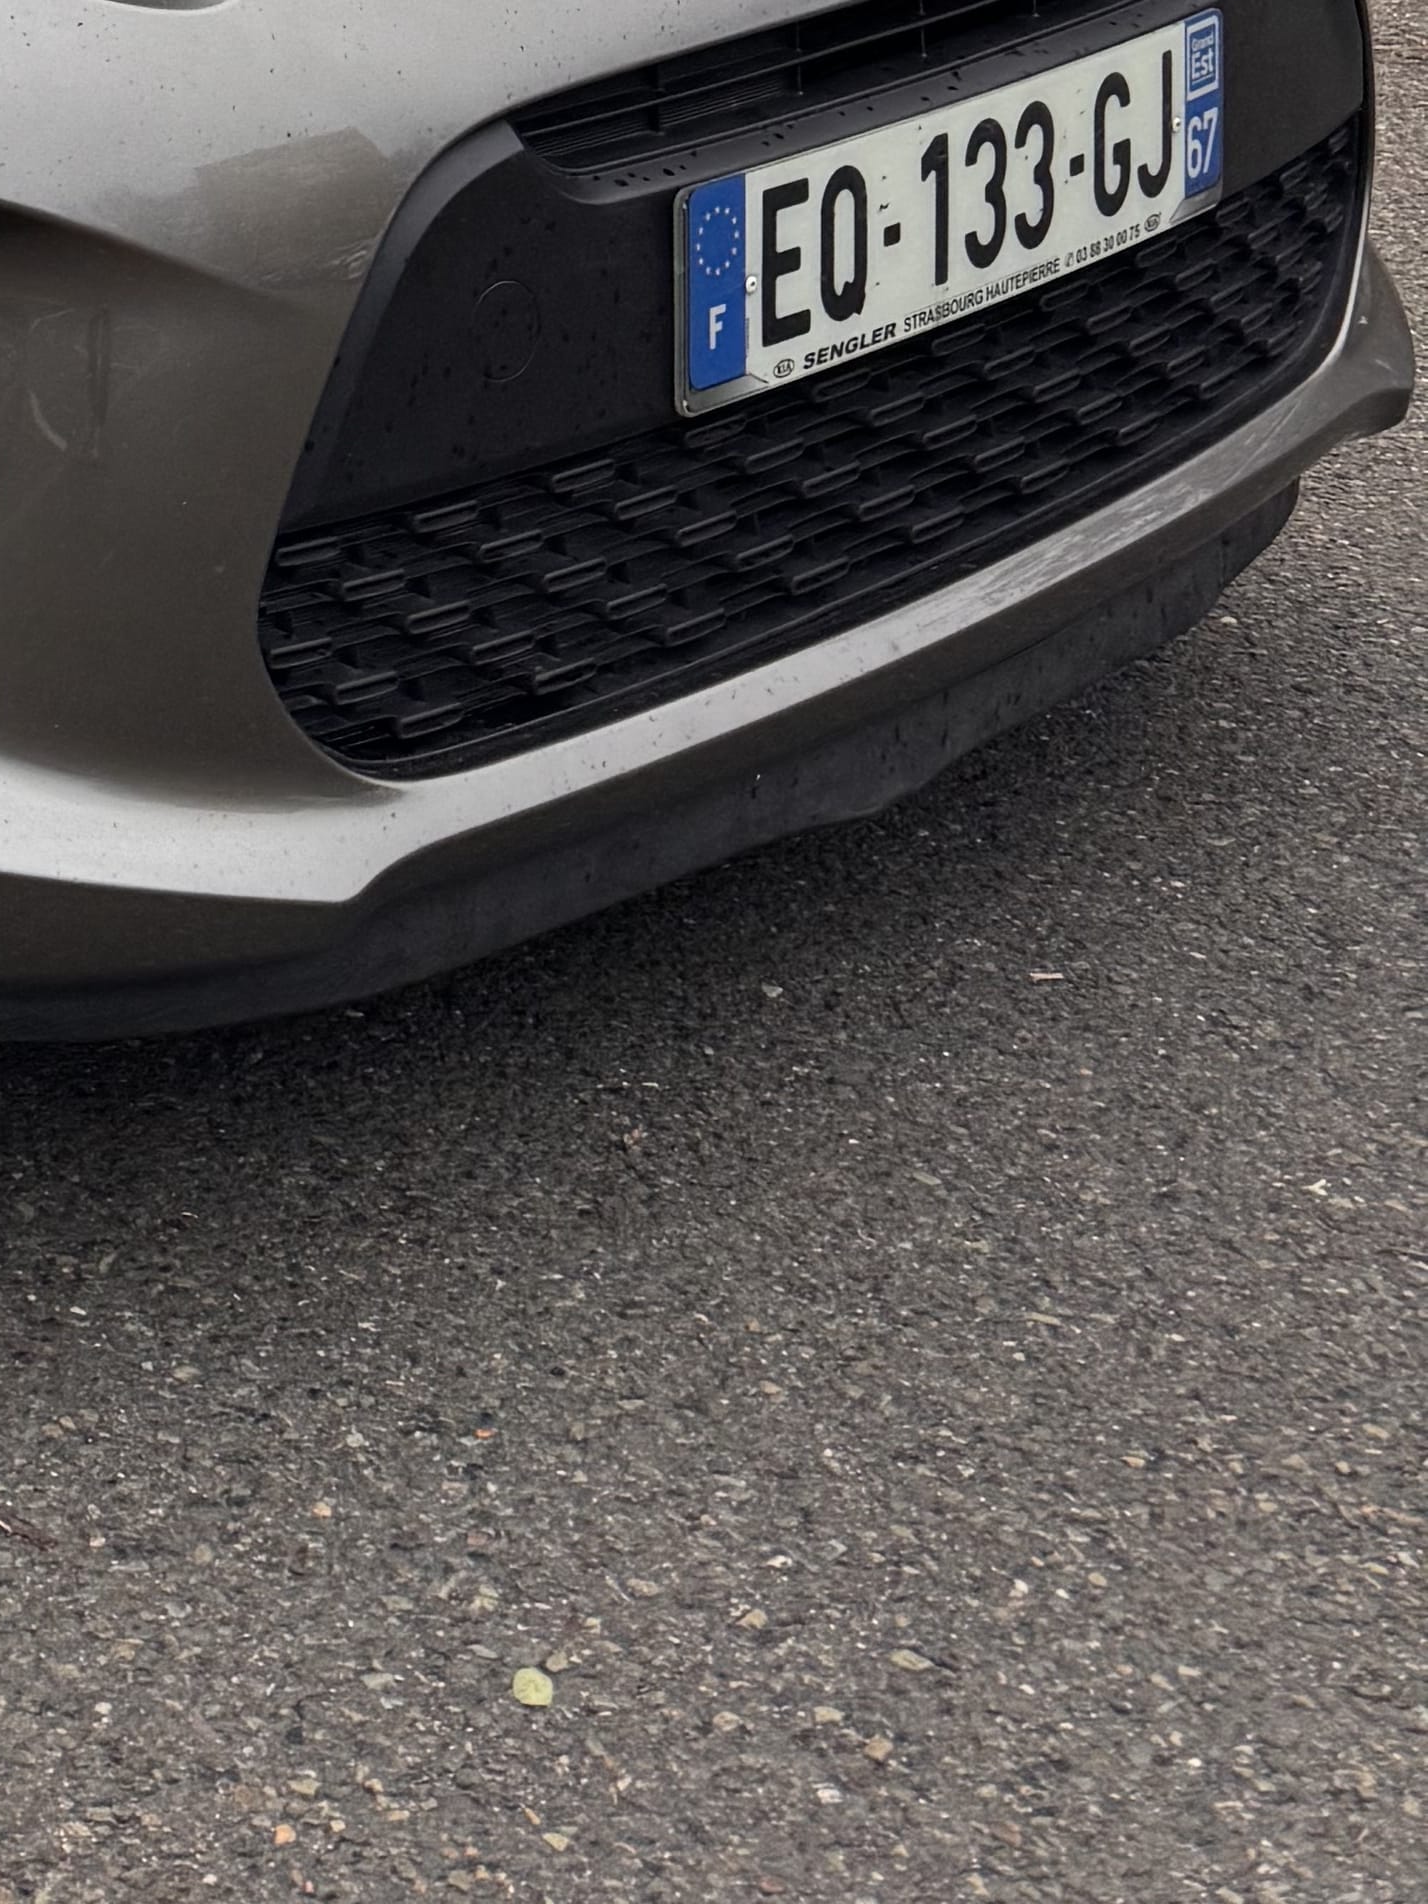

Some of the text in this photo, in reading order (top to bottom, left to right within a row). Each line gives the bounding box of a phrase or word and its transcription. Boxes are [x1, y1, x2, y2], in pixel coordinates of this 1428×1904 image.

[1191, 47, 1214, 81] Est
[1186, 106, 1219, 179] 67
[761, 50, 1173, 348] EQ-133-GJ
[709, 303, 727, 350] F
[802, 322, 897, 370] SENGLER
[903, 289, 984, 333] STRASBOURG
[985, 257, 1061, 303] HAUTEPIERRE
